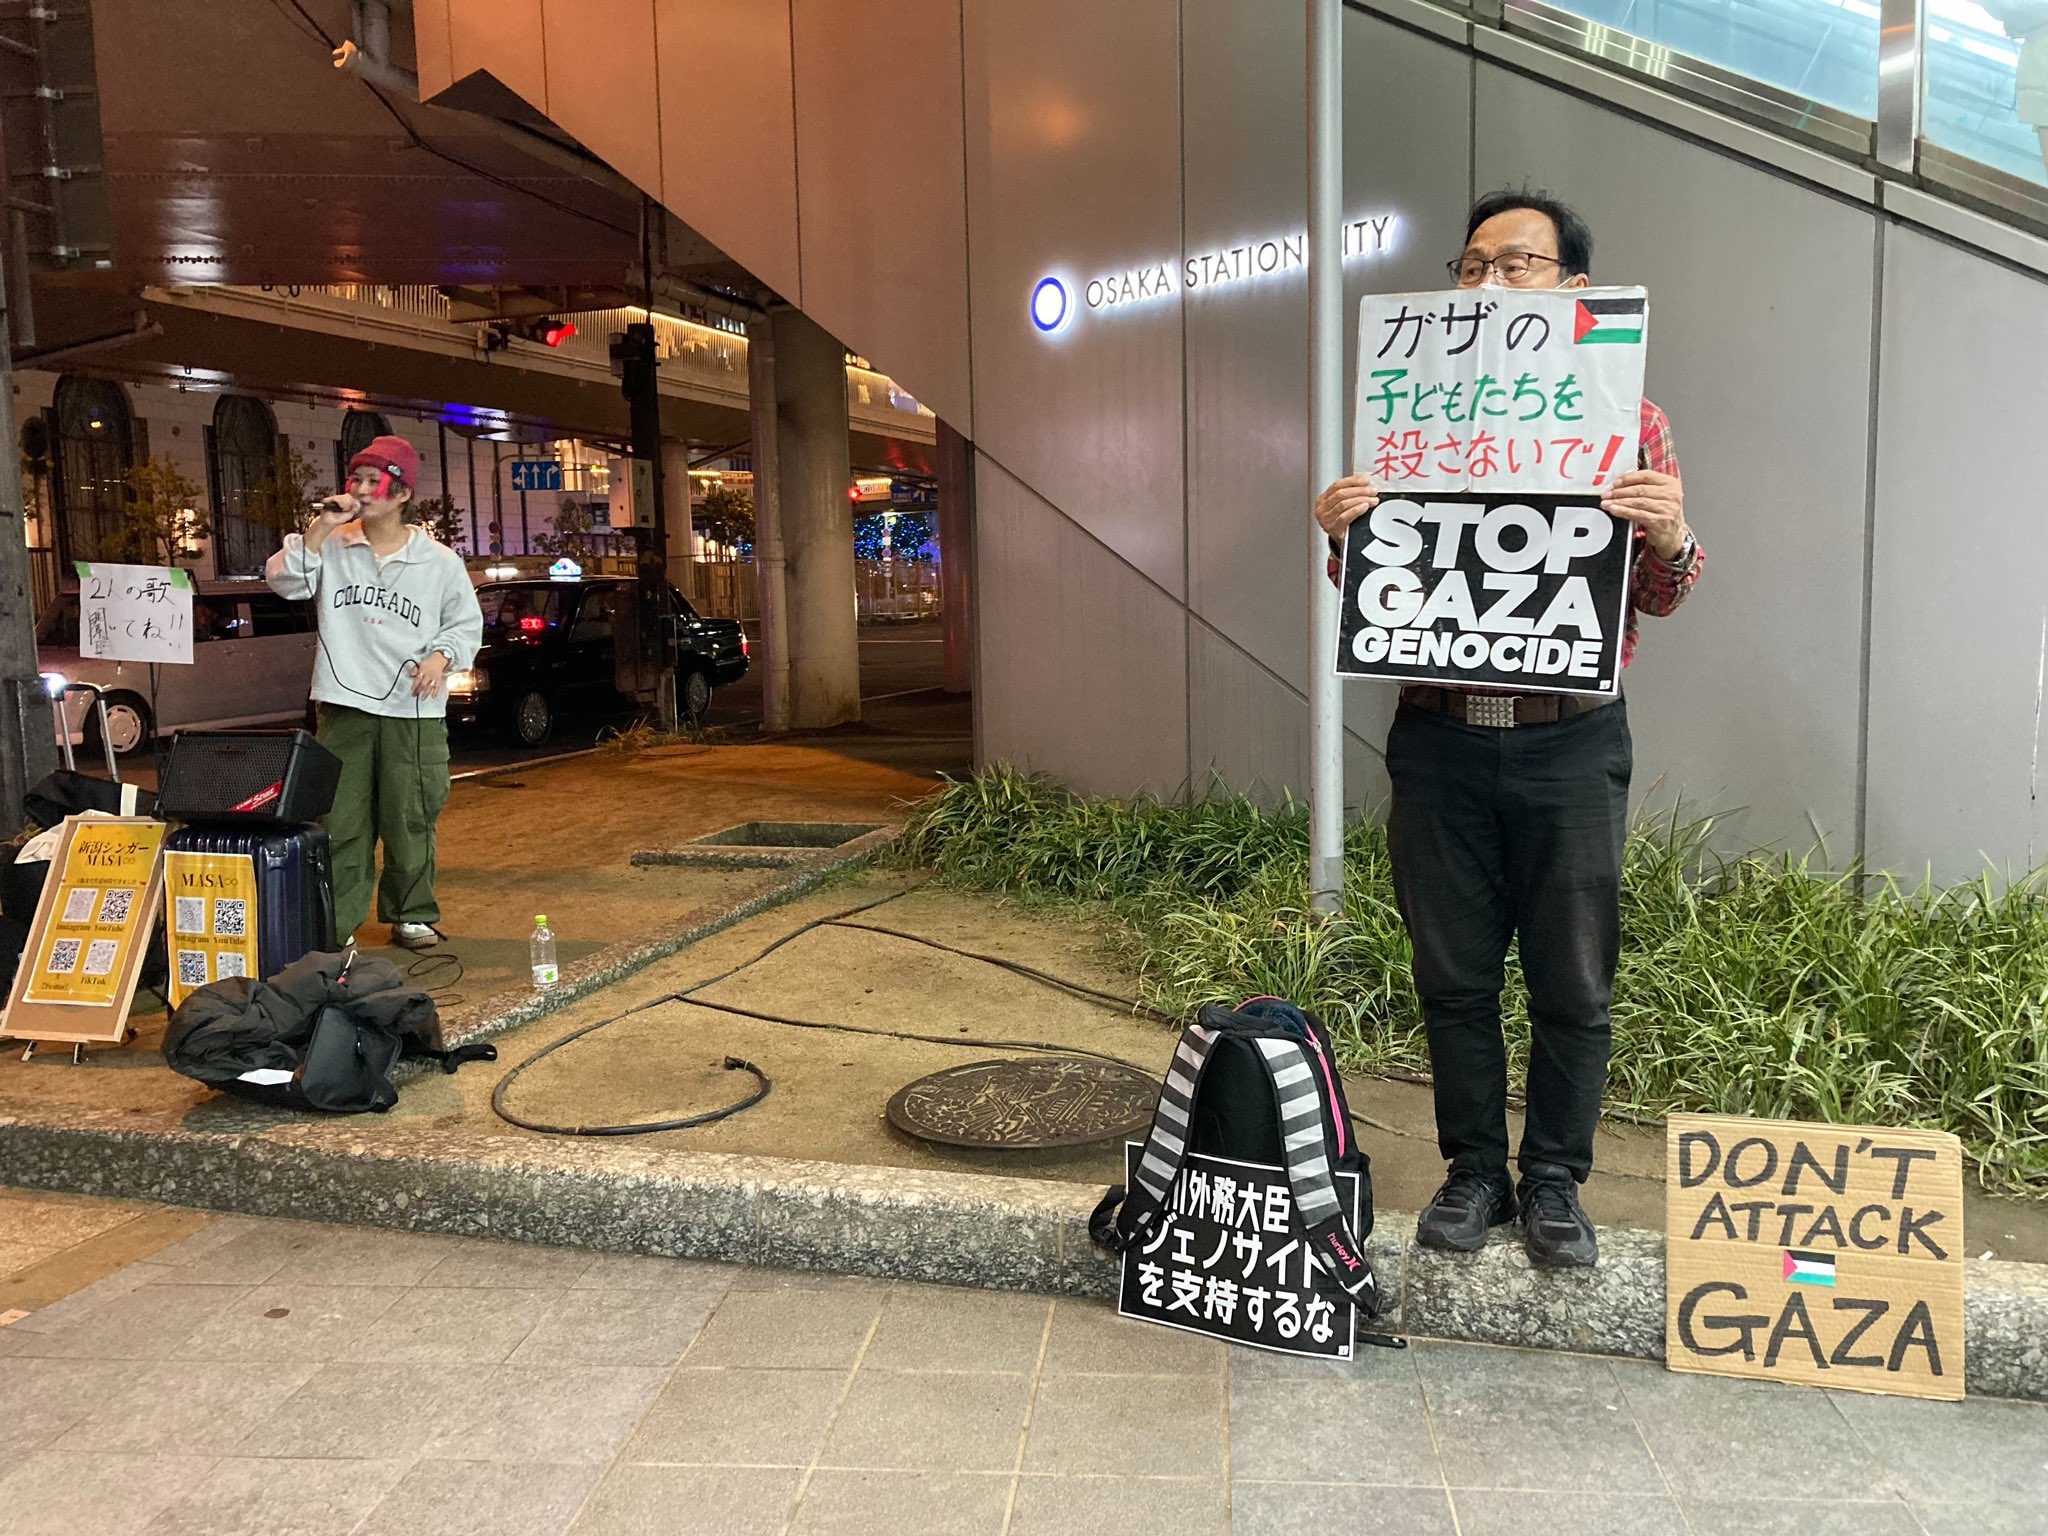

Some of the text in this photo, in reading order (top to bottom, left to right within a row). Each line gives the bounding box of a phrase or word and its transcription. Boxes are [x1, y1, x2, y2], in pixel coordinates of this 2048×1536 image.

[1085, 215, 1397, 309] OSAKA STATION ITY
[1377, 300, 1550, 359] ガザの
[1366, 368, 1584, 425] 子どもたちを
[1371, 429, 1626, 487] 殺さないで!
[1360, 499, 1614, 575] STOP
[89, 576, 176, 606] 2人の歌
[333, 584, 422, 628] COLORADO
[1357, 566, 1603, 640] GAZA
[1352, 626, 1603, 678] GENOCIDE
[78, 839, 150, 855] 新潟シンガー
[94, 923, 125, 933] YouTube
[213, 936, 248, 946] YouTube
[80, 976, 107, 986] TikTok
[1678, 1130, 1937, 1200] DON'T
[1689, 1191, 1948, 1261] ATTACK
[1137, 1260, 1336, 1345] を支持するな
[1677, 1280, 1944, 1377] GAZA
